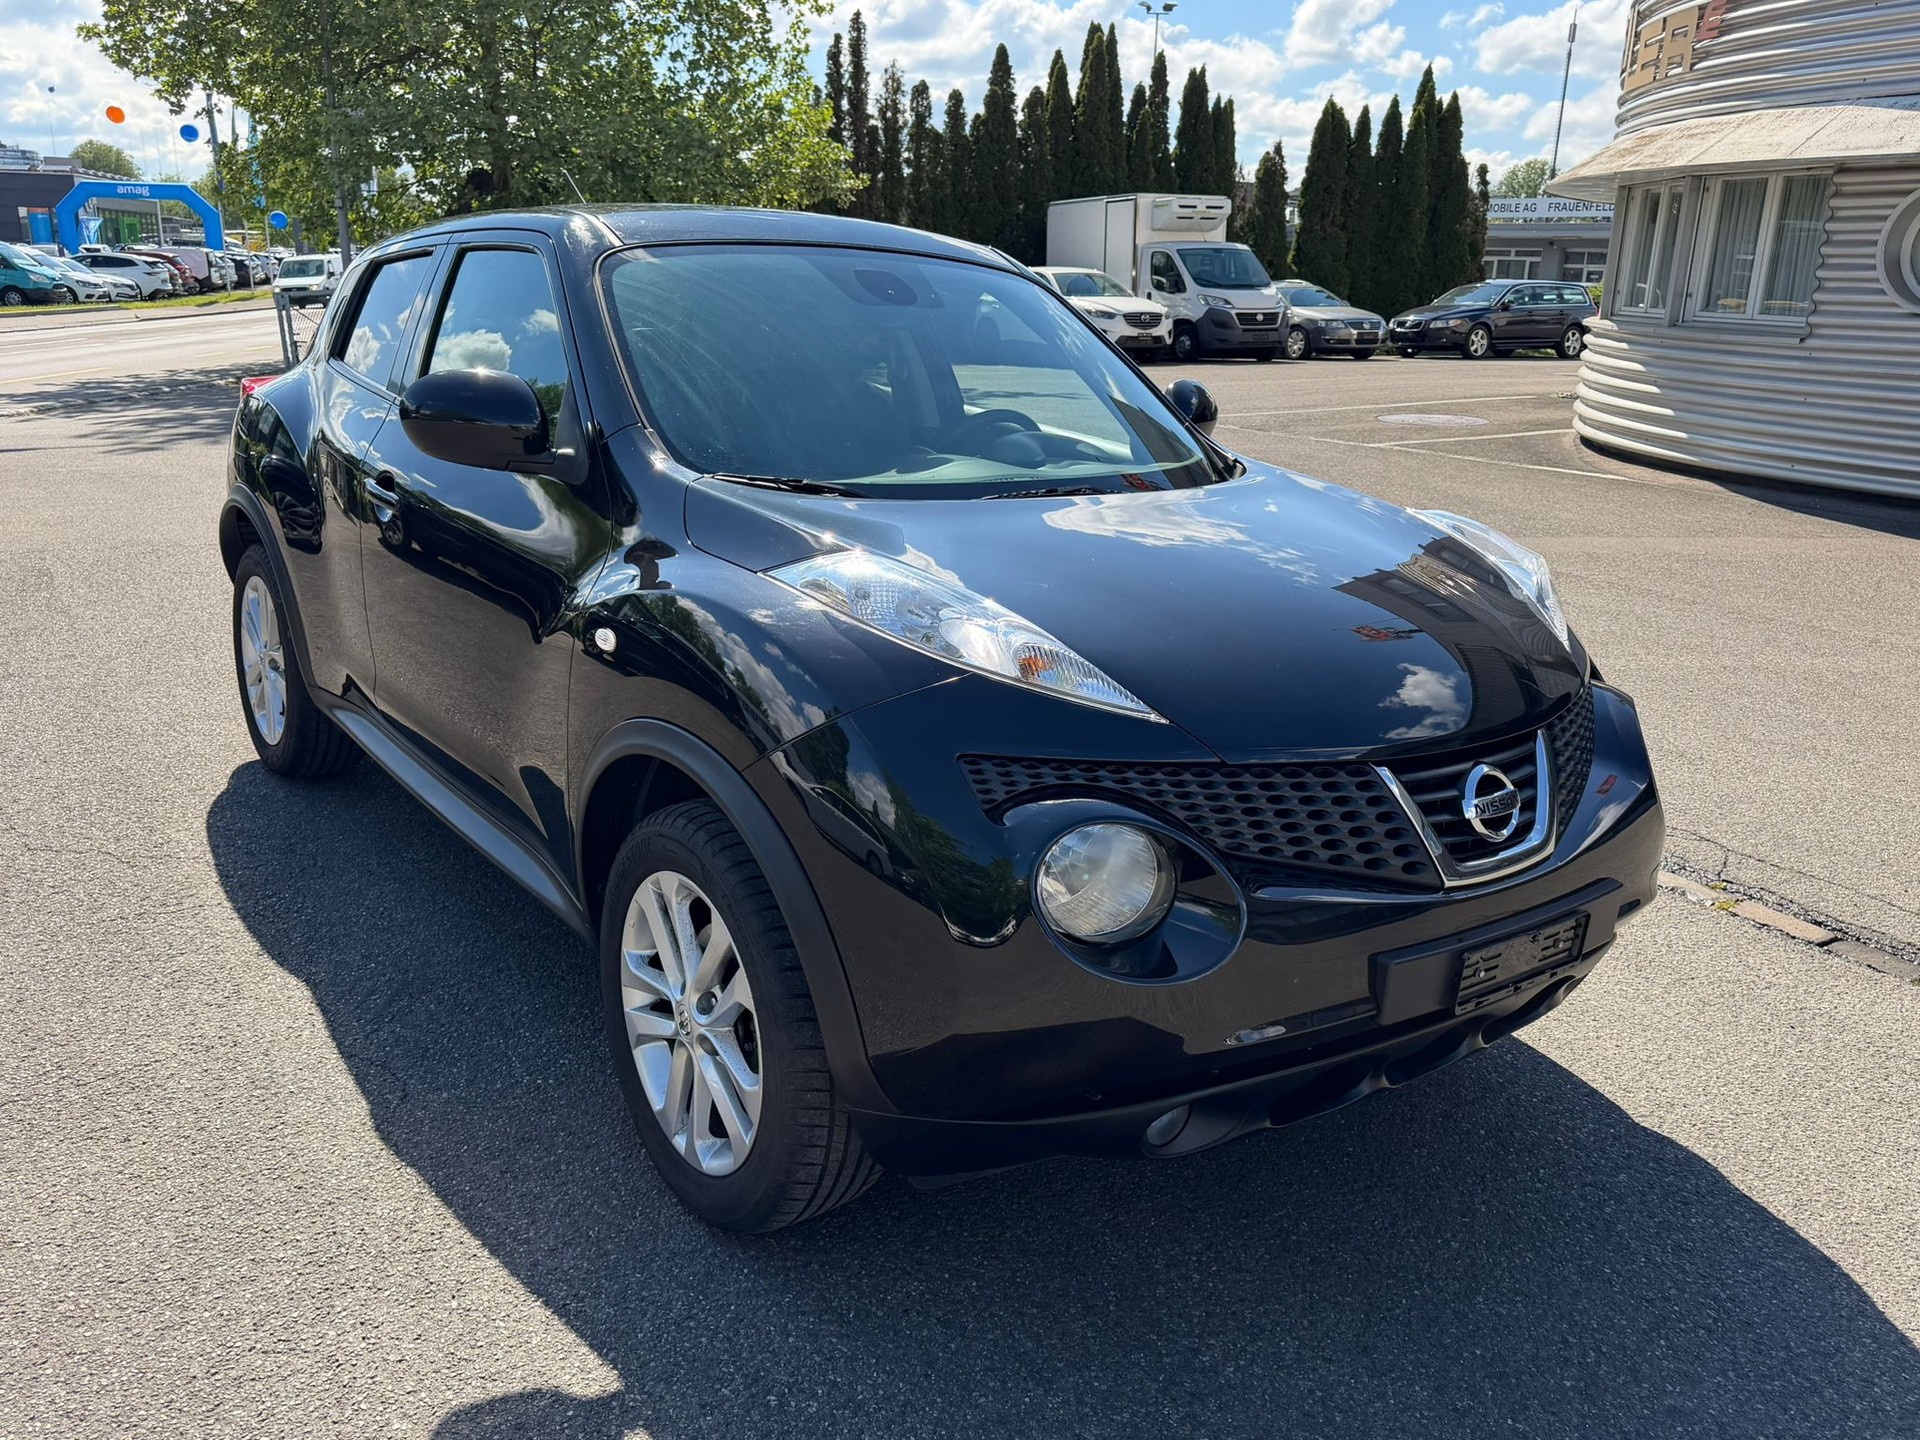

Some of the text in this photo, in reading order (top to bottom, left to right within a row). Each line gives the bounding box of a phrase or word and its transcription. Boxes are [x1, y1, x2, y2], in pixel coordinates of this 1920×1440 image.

[117, 185, 150, 196] amag
[1522, 203, 1537, 212] AG
[1548, 201, 1615, 212] FRAUENFELD
[1474, 793, 1518, 815] NISSAN
